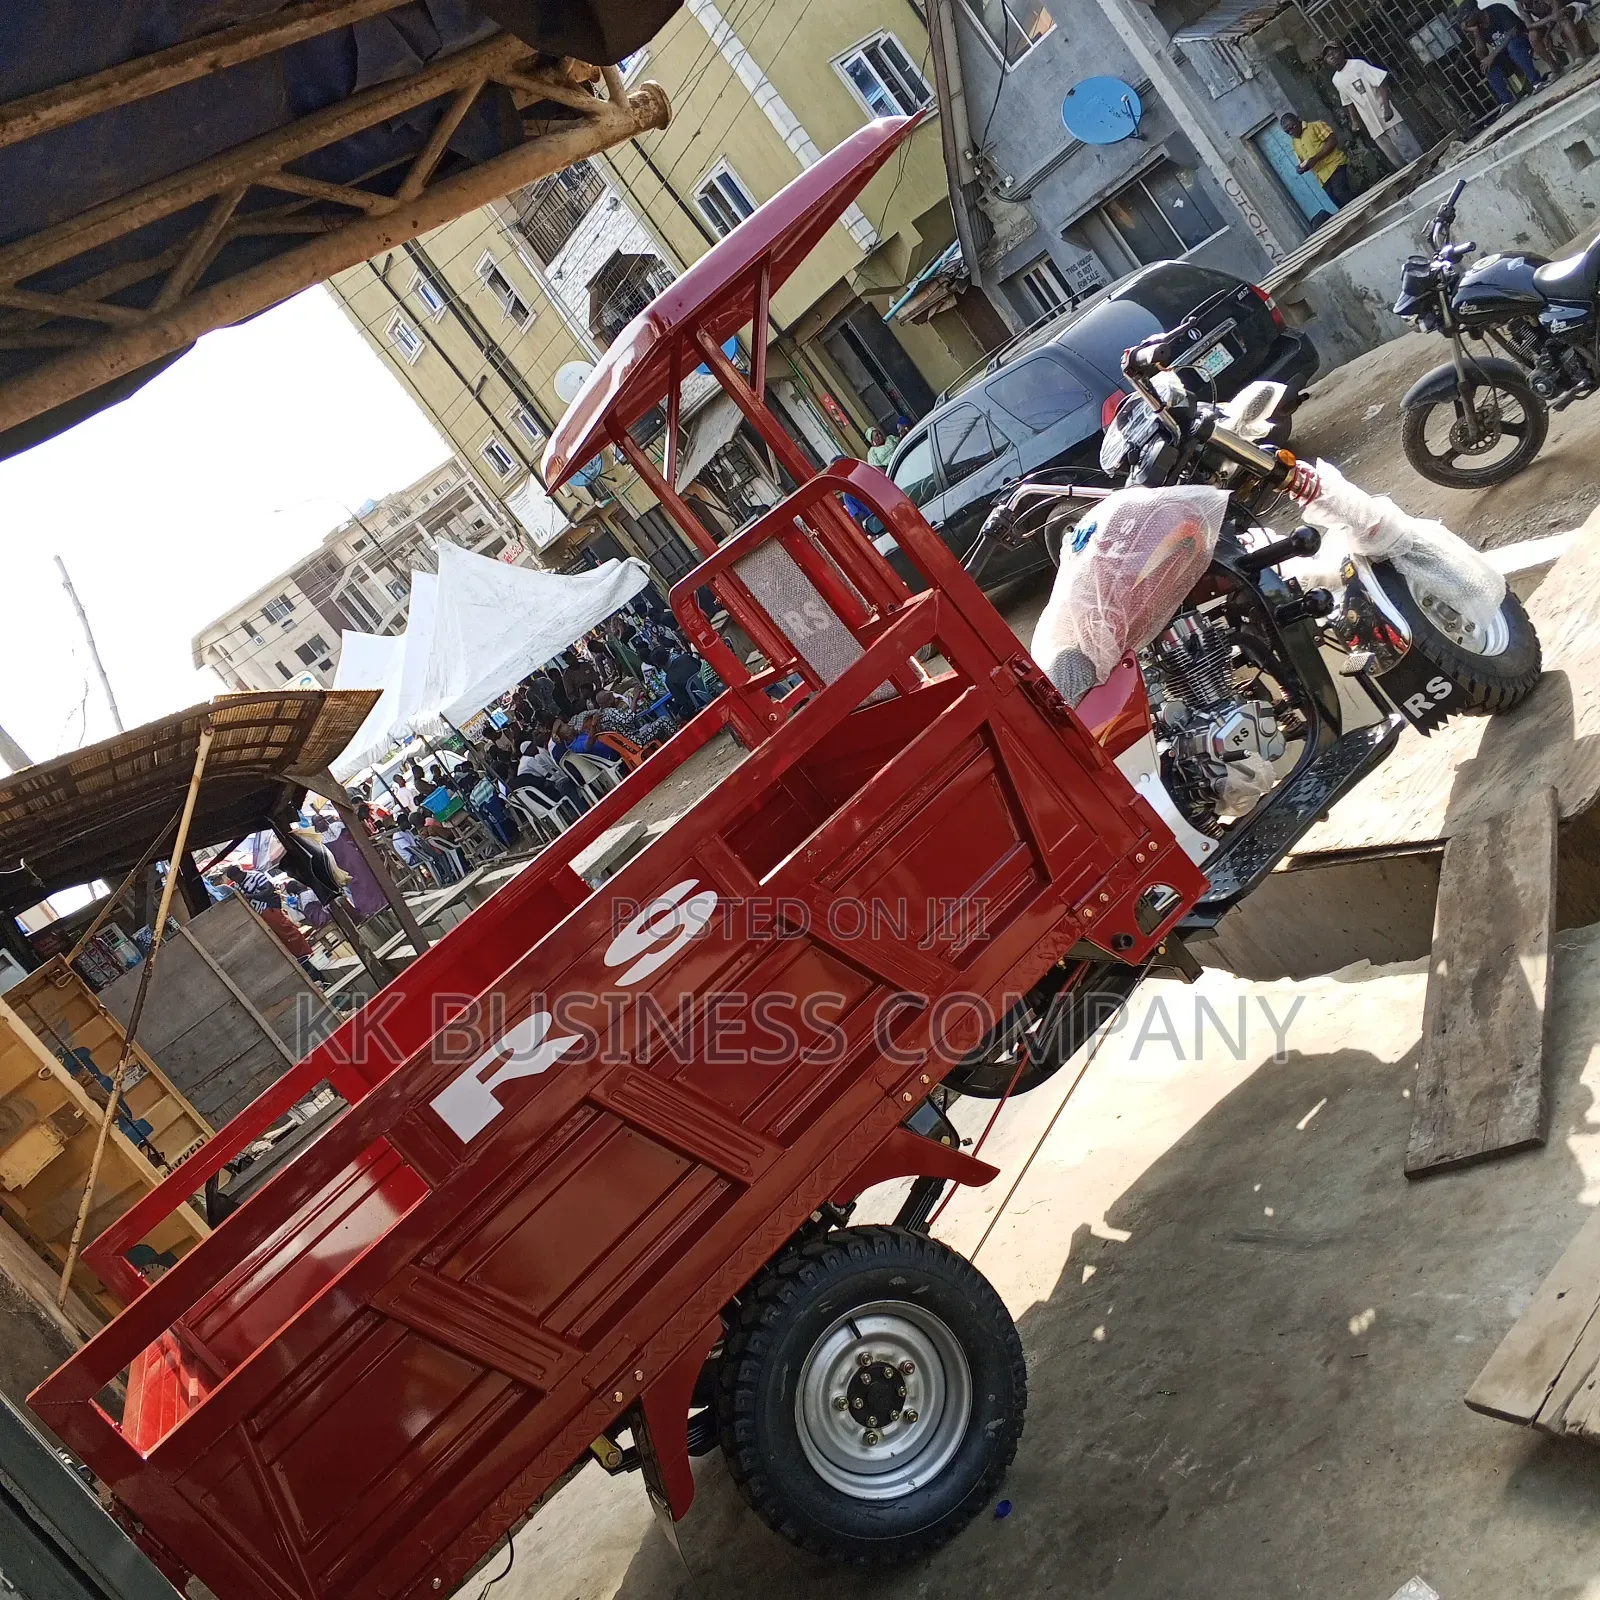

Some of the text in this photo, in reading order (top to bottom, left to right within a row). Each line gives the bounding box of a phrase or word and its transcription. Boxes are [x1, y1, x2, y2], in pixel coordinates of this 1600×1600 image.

[1077, 253, 1094, 268] HOUSE
[1076, 263, 1093, 279] IS NOT
[1077, 270, 1101, 290] FOR SALE
[784, 601, 830, 640] RS
[1403, 676, 1453, 719] RS
[1231, 727, 1250, 747] RS
